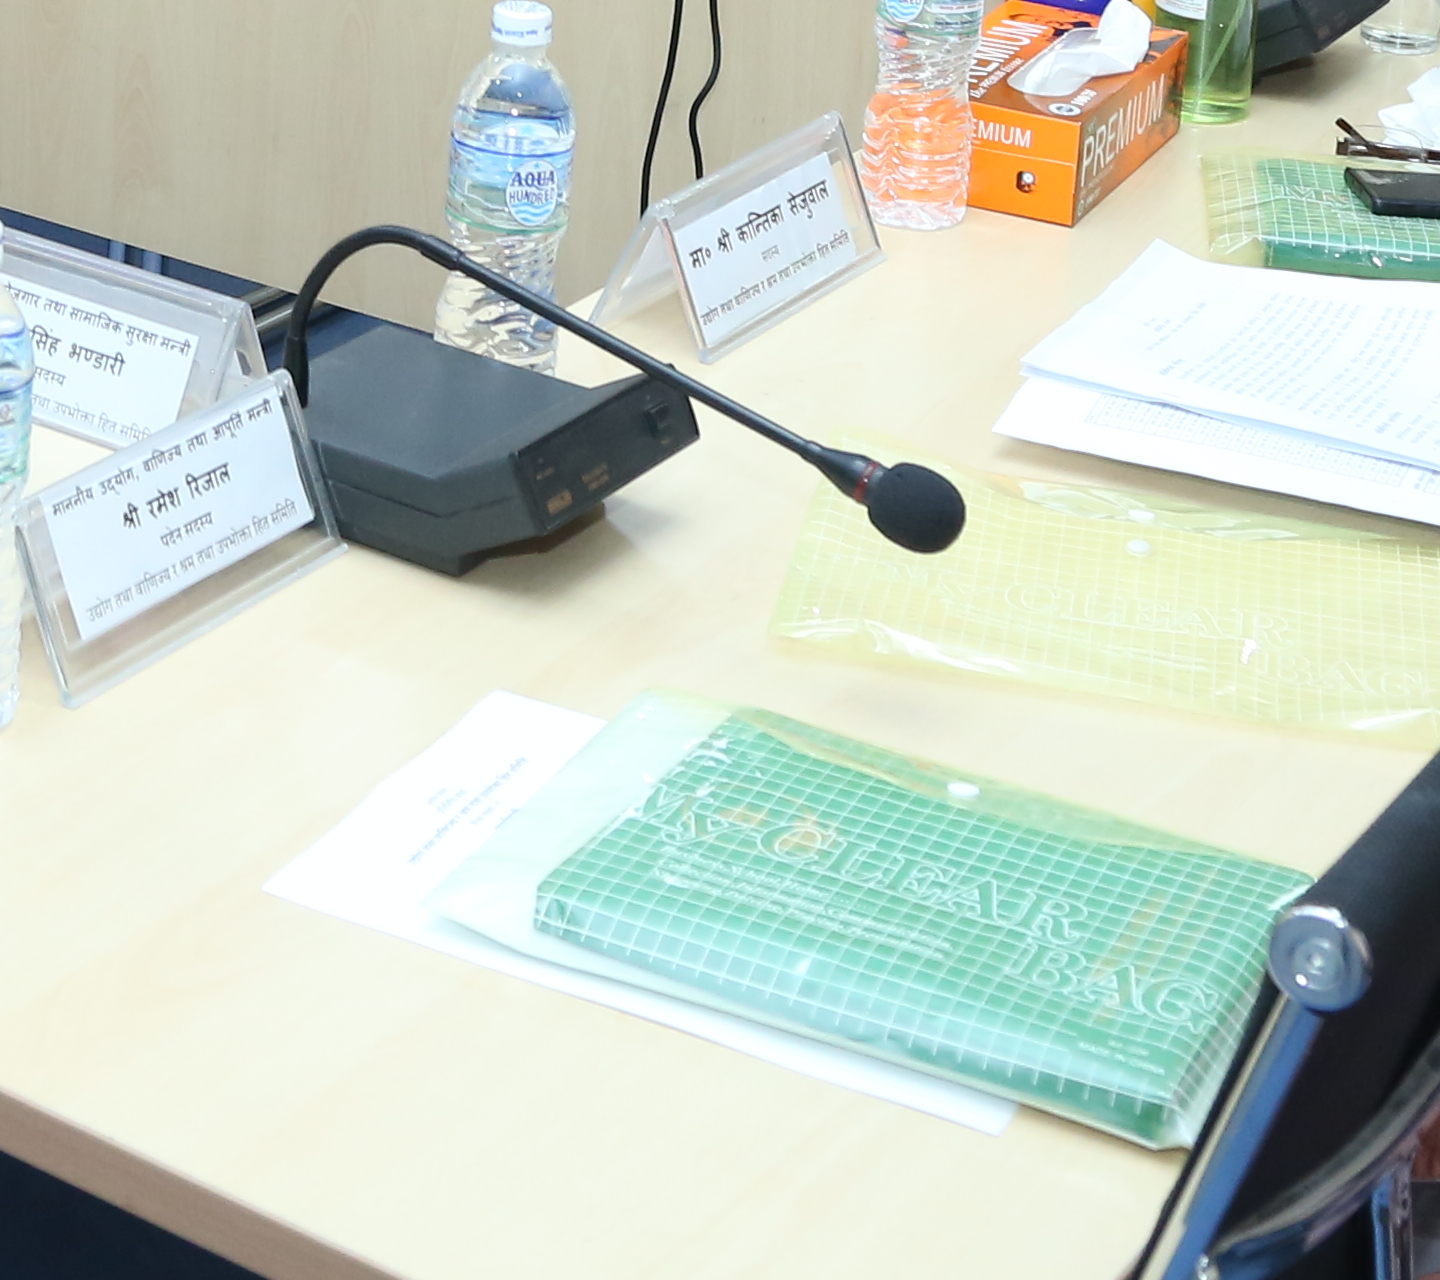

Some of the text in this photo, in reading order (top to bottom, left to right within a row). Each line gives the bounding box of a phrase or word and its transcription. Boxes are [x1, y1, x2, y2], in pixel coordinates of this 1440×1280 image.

[971, 119, 1031, 148] EMIUM
[1080, 73, 1165, 188] PREMIUM
[509, 189, 556, 206] HUNDRED
[510, 169, 556, 188] AQUA
[717, 228, 734, 253] श्री
[735, 204, 785, 243] कान्तिका
[787, 179, 831, 220] सेजुवाल
[43, 297, 191, 358] तथा सामाजिक सुरक्षा मन्त्री
[69, 343, 126, 377] भण्डारी
[52, 401, 96, 426] उपभोक्ता
[98, 412, 117, 434] हित
[51, 486, 94, 517] माननीय
[142, 443, 182, 474] वाणिज्य
[186, 432, 209, 454] तथा
[212, 410, 244, 440] आपूर्ति
[246, 398, 273, 423] मन्त्री
[122, 462, 232, 530] श्री रमेश रिजाल
[86, 497, 298, 623] उद्योग तथा वाणिज्य र श्रम तथा उपभोक्ता हित समिति
[160, 511, 214, 549] पदेन सदस्य
[757, 823, 1088, 946] CLEAR
[1005, 937, 1219, 1034] BAG
